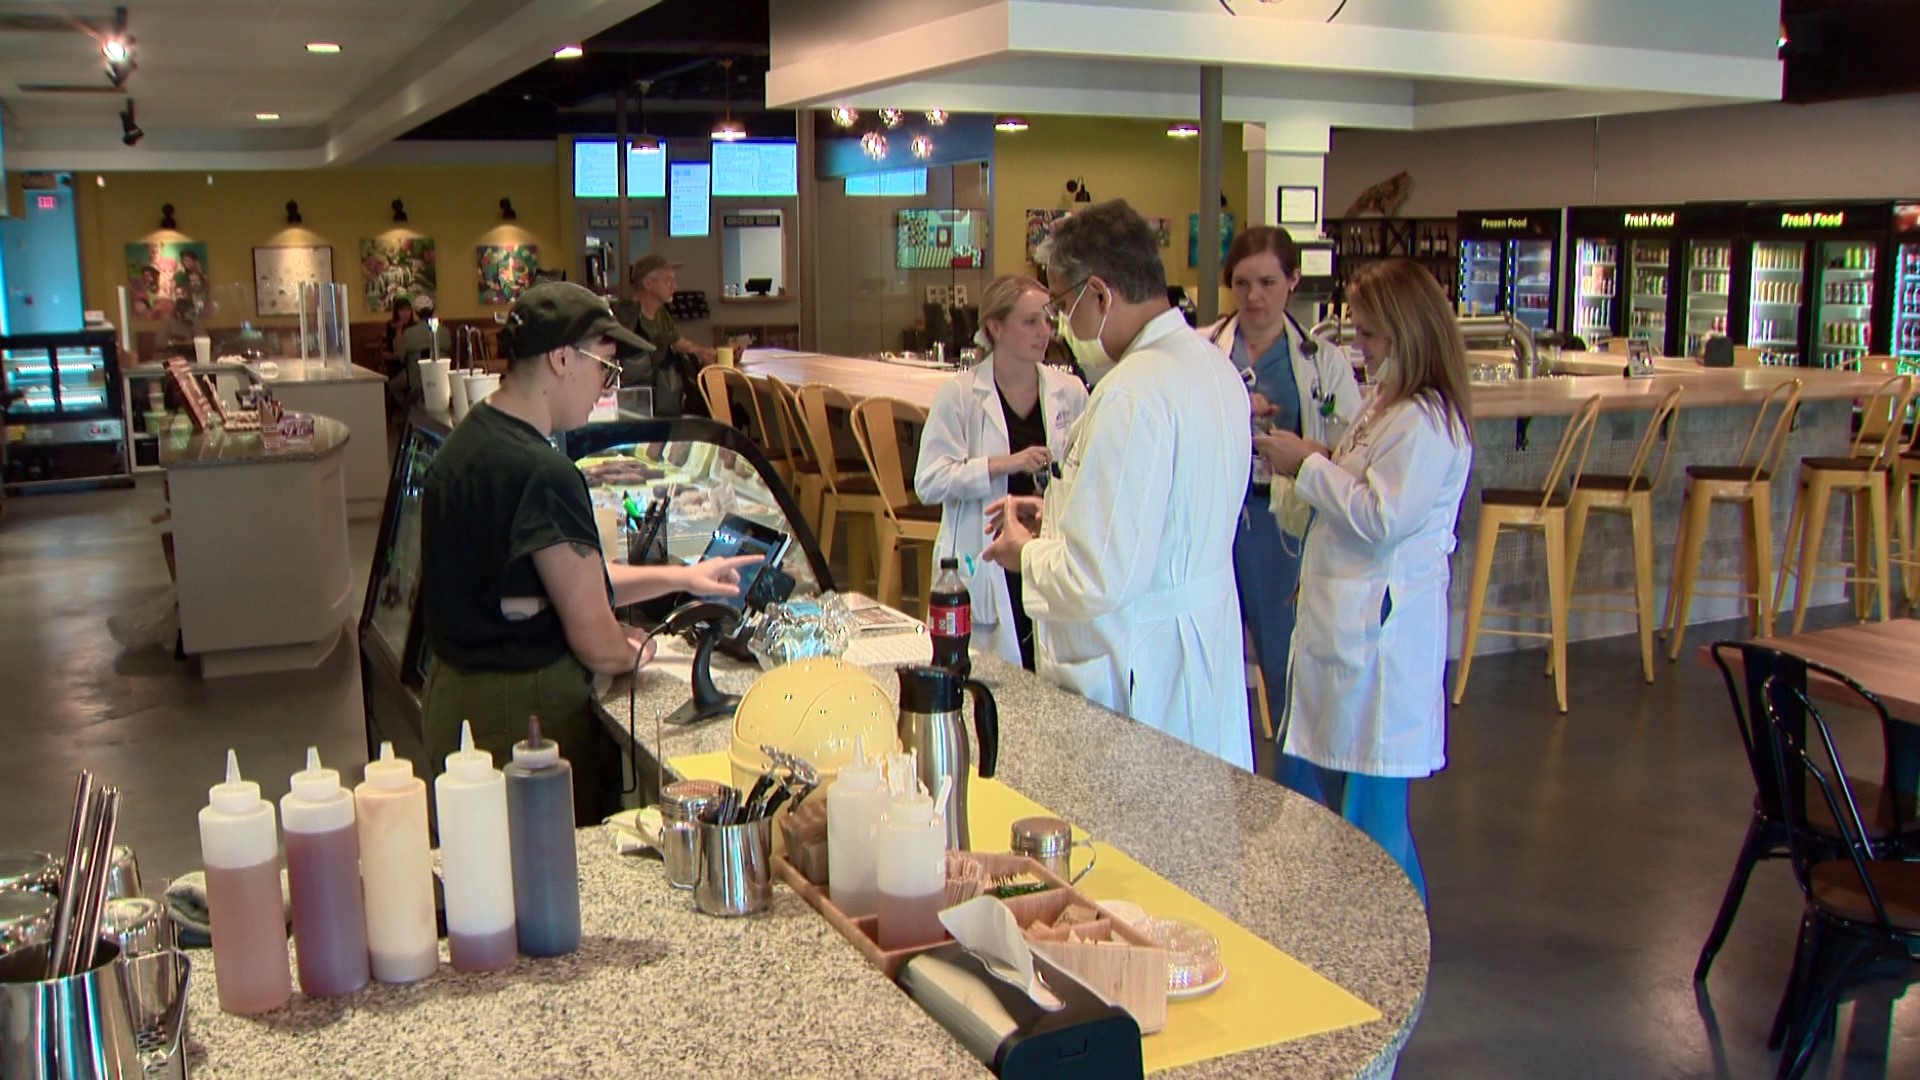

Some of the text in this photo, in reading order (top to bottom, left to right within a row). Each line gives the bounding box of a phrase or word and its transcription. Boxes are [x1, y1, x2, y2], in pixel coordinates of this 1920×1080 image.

[1507, 217, 1528, 229] Food
[1624, 212, 1675, 227] Fresh Food
[1781, 211, 1844, 228] Fresh Food
